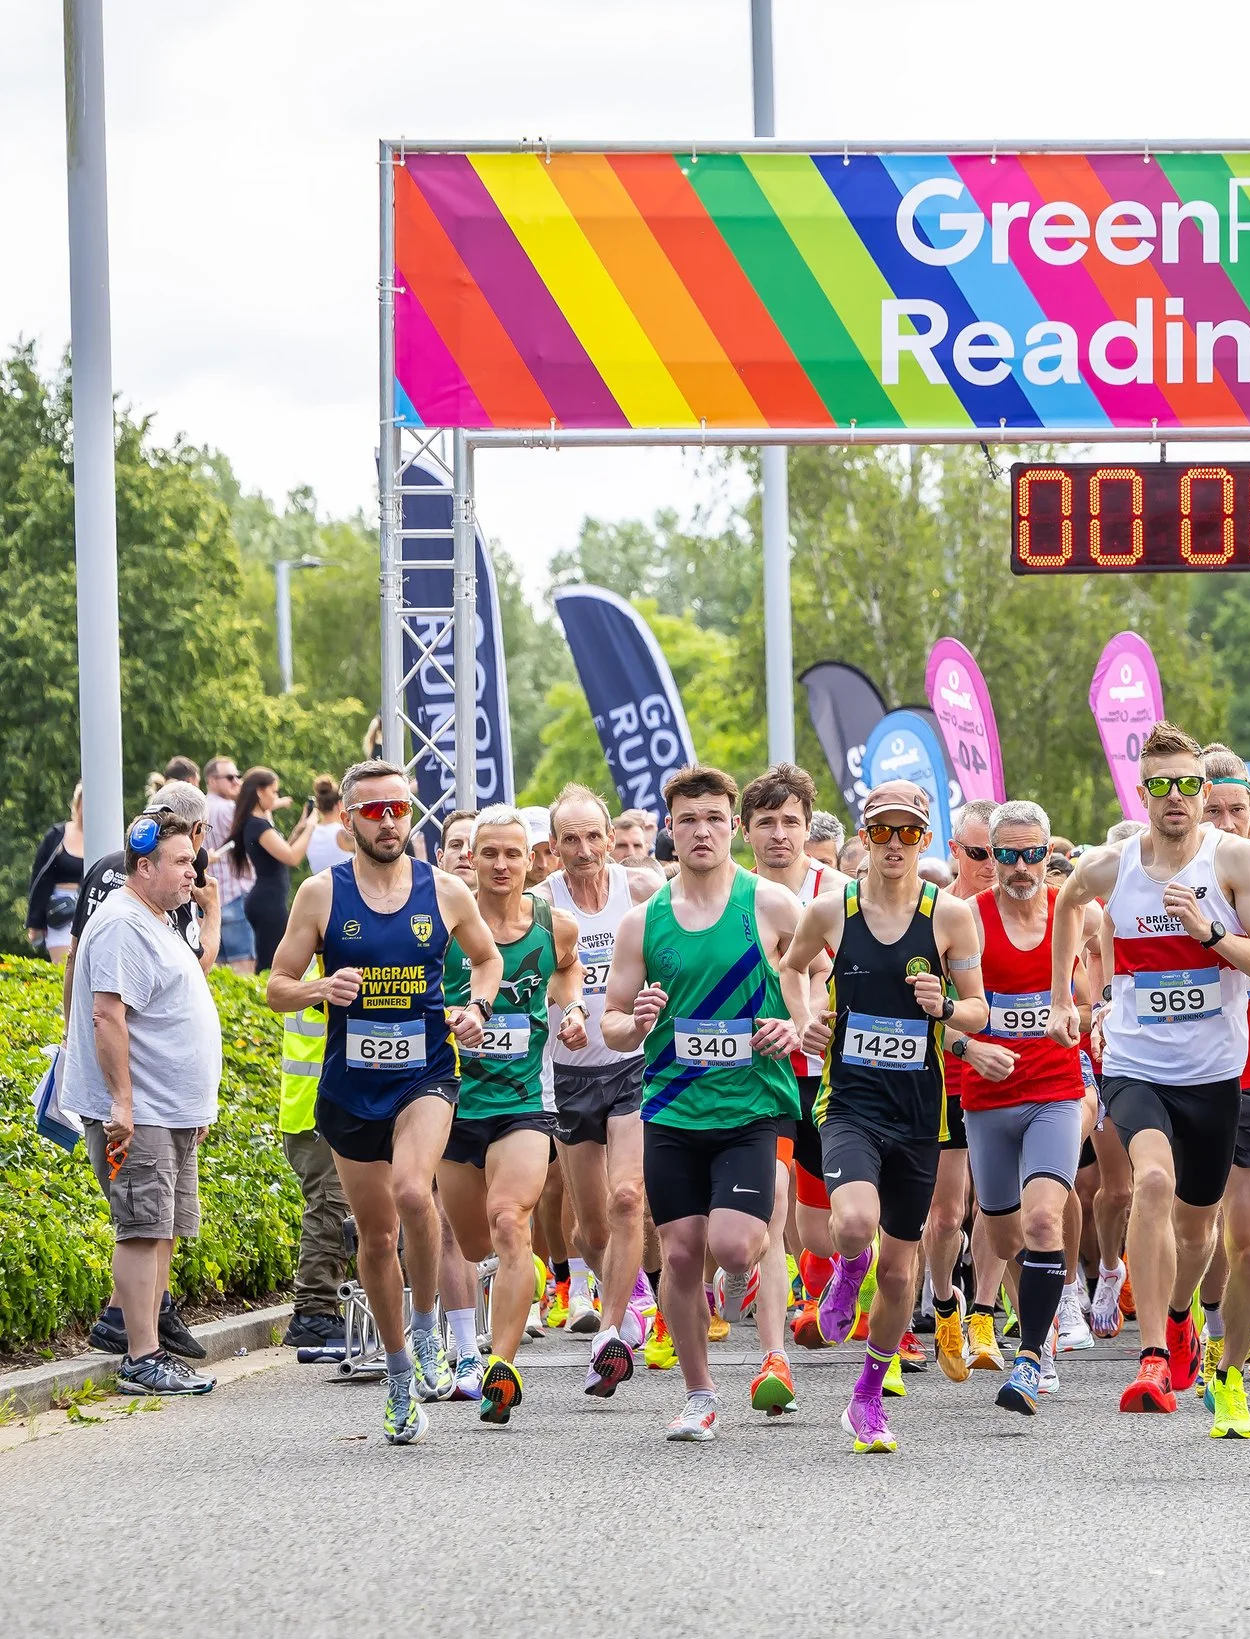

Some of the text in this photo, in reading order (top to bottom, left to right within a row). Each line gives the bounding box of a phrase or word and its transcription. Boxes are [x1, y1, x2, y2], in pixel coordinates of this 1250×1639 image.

[1017, 468, 1143, 566] 00
[1153, 924, 1181, 932] WEST
[581, 932, 614, 943] BRISTOL
[588, 940, 609, 949] WEST
[355, 965, 425, 981] ARGRAVE
[360, 980, 427, 995] TWYFORD
[366, 998, 408, 1007] RUNNERS
[1149, 988, 1205, 1013] 969
[1003, 1008, 1051, 1029] 993
[360, 1038, 410, 1060] 628
[687, 1036, 737, 1058] 340
[853, 1033, 917, 1060] 1429
[877, 1061, 907, 1069] RUNNING
